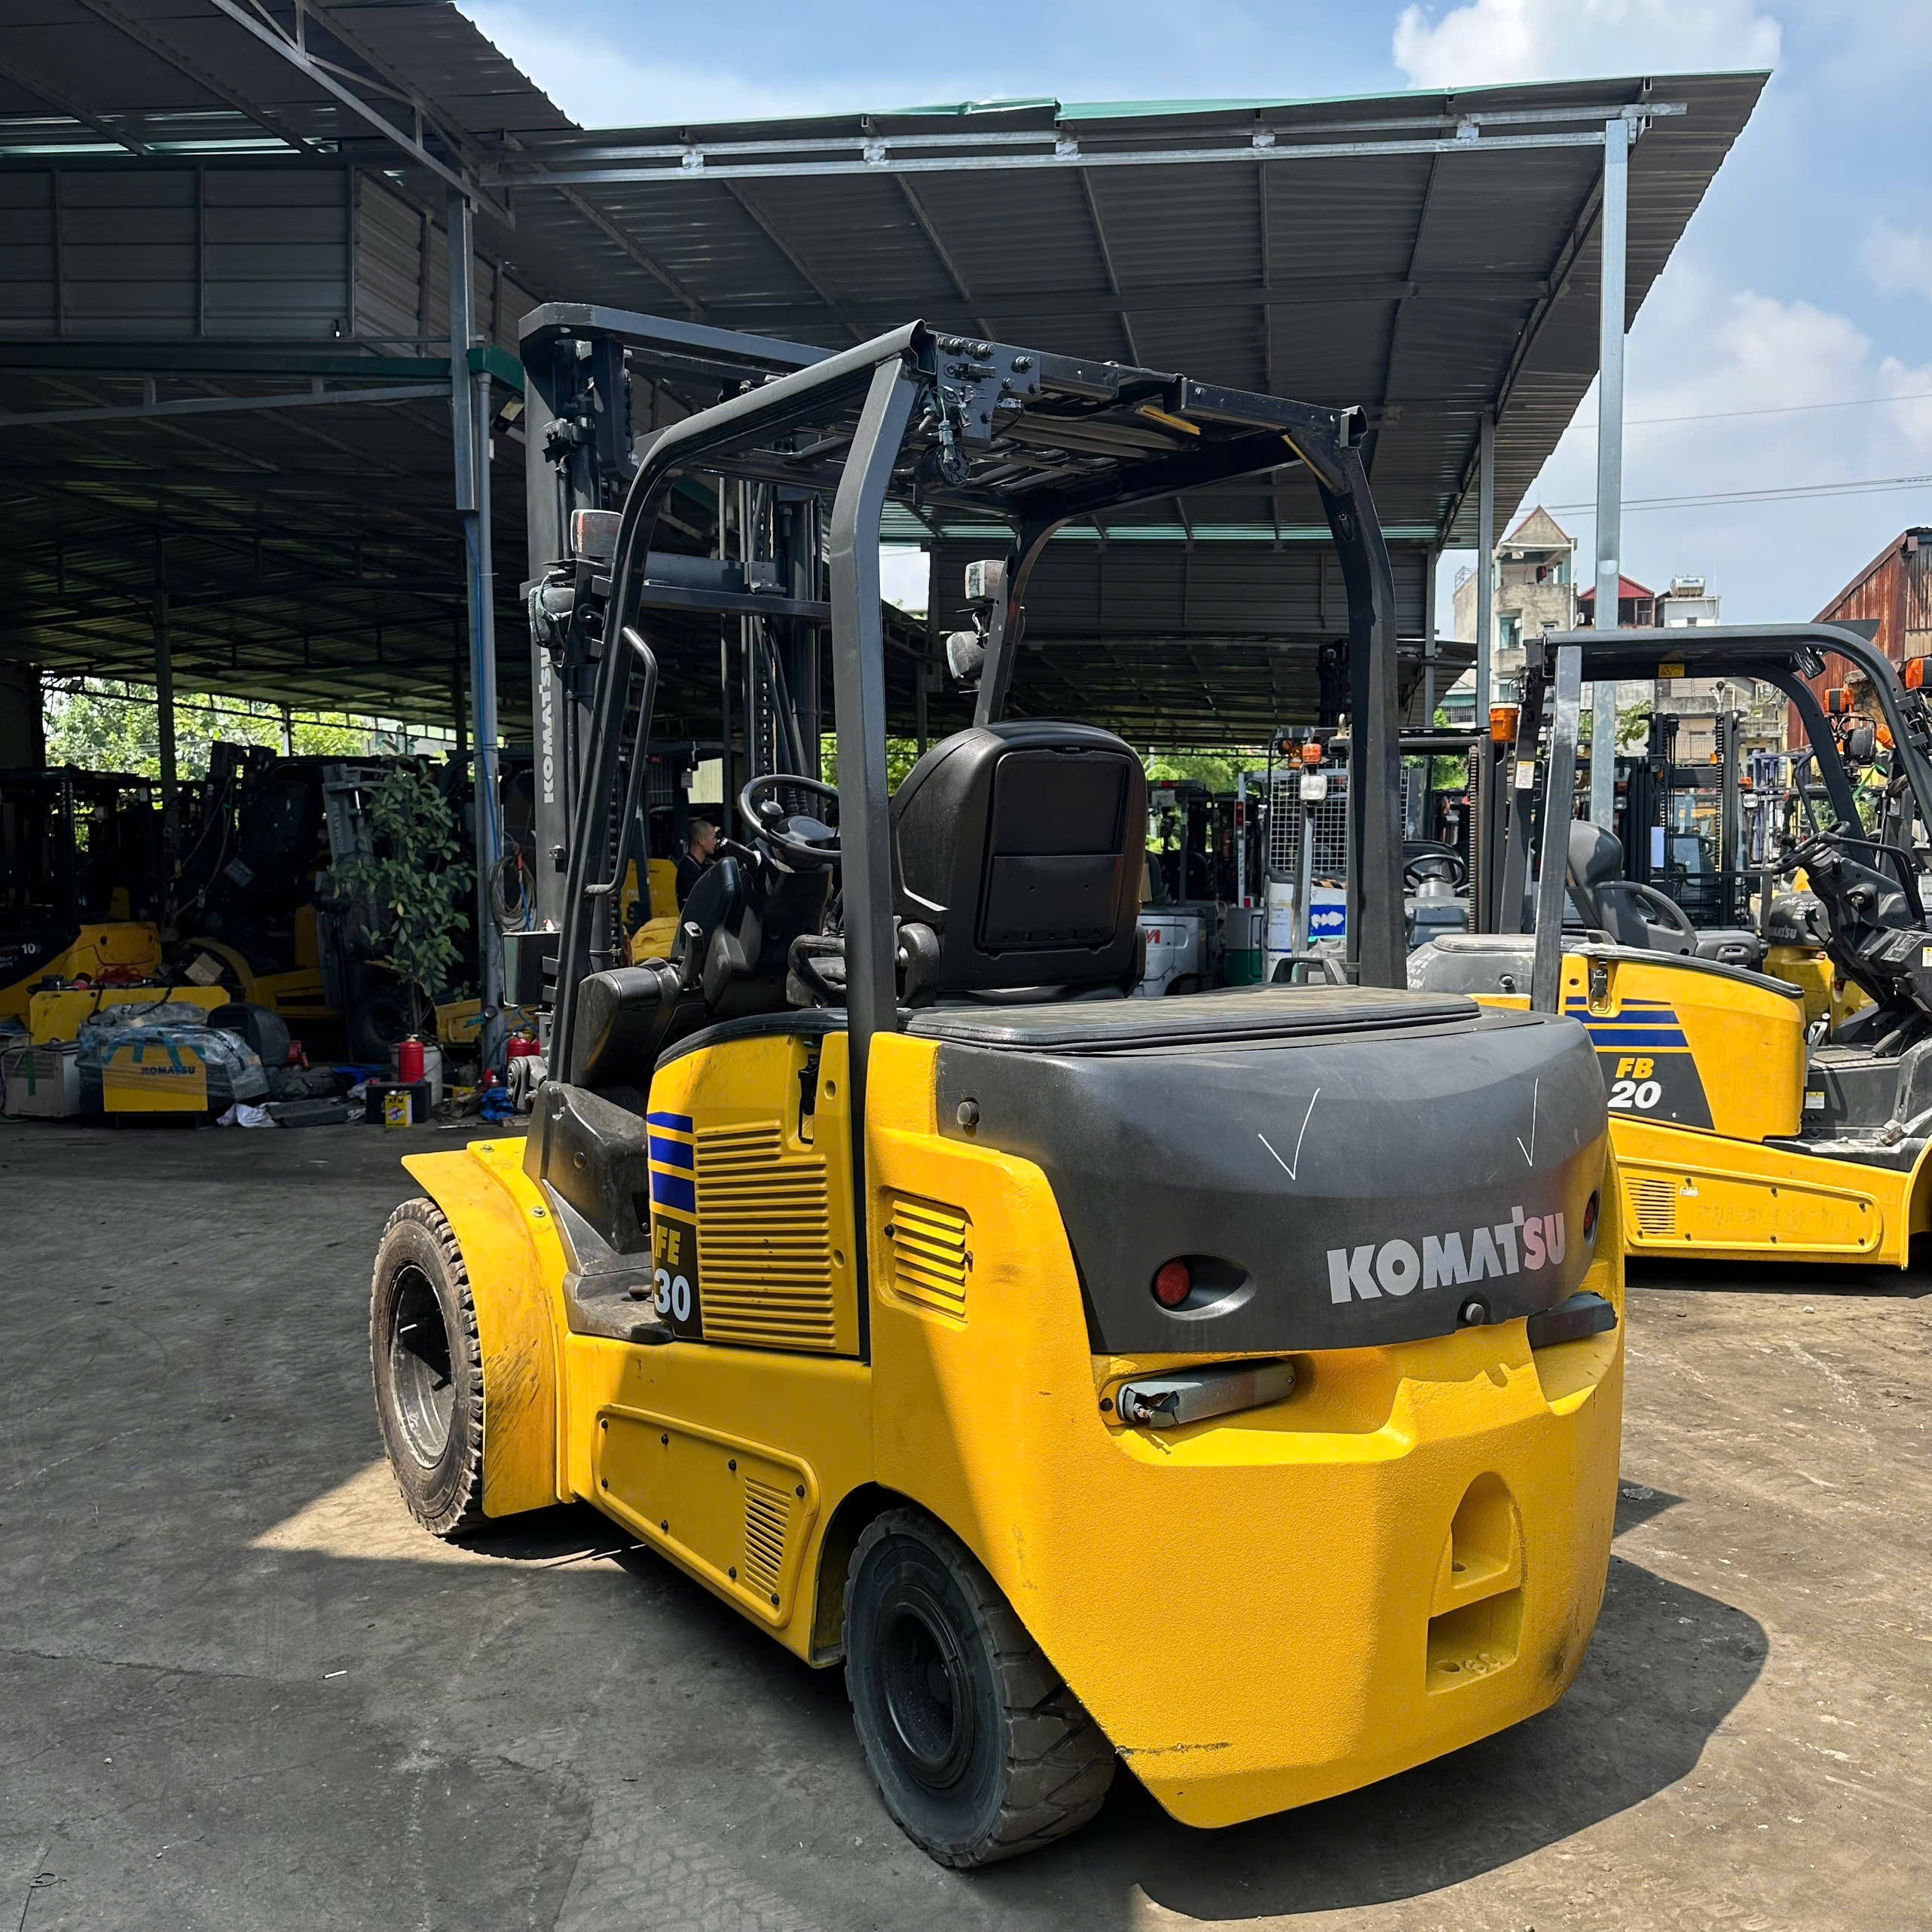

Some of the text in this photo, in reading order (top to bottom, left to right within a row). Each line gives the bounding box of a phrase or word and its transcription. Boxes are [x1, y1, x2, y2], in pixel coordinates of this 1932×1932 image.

[538, 647, 554, 803] KOMATSU
[1615, 1057, 1655, 1078] FB
[1607, 1080, 1661, 1108] 20
[656, 1224, 680, 1265] FE
[1327, 1206, 1566, 1304] KOMATSU
[654, 1268, 691, 1322] 30
